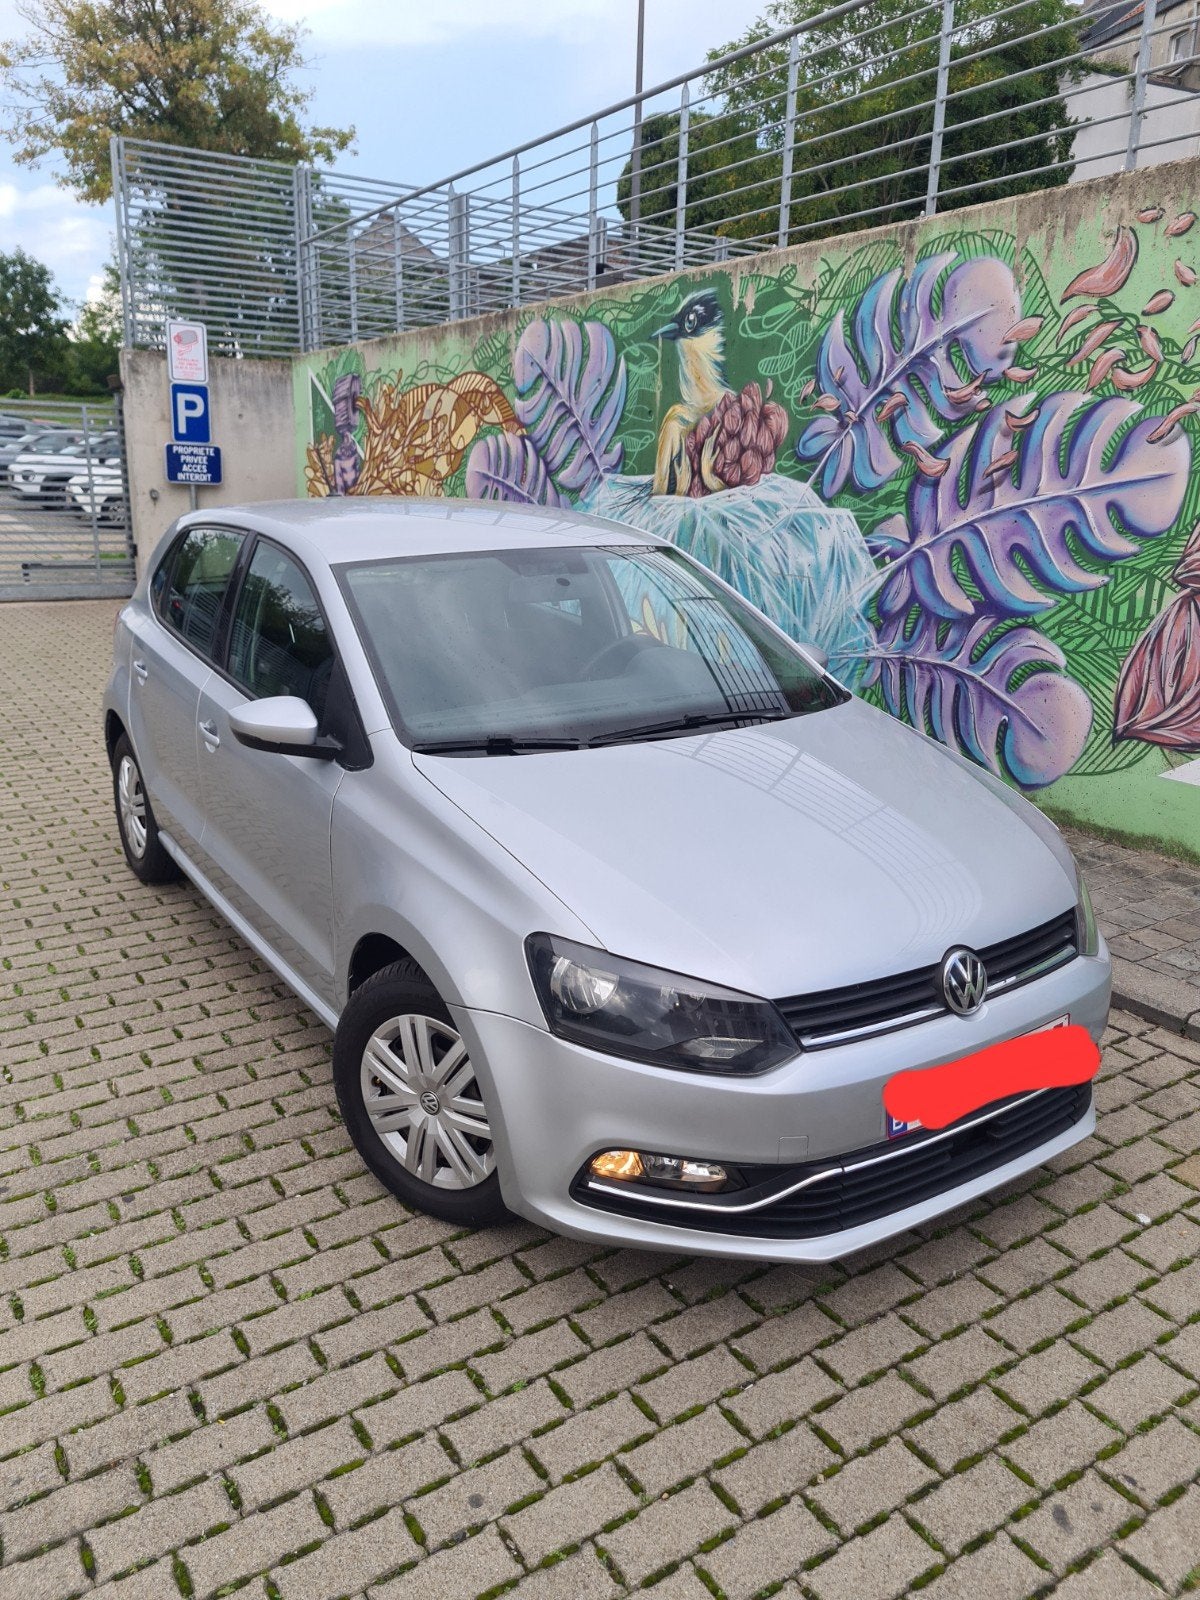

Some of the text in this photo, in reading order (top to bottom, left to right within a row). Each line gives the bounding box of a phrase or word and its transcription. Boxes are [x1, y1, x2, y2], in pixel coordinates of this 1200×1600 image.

[177, 392, 204, 434] P
[172, 445, 215, 456] PROPRIETE
[180, 455, 208, 465] PRIVEE
[182, 463, 208, 473] ACCES
[177, 472, 212, 482] INTERDIT
[945, 952, 986, 1012] VW
